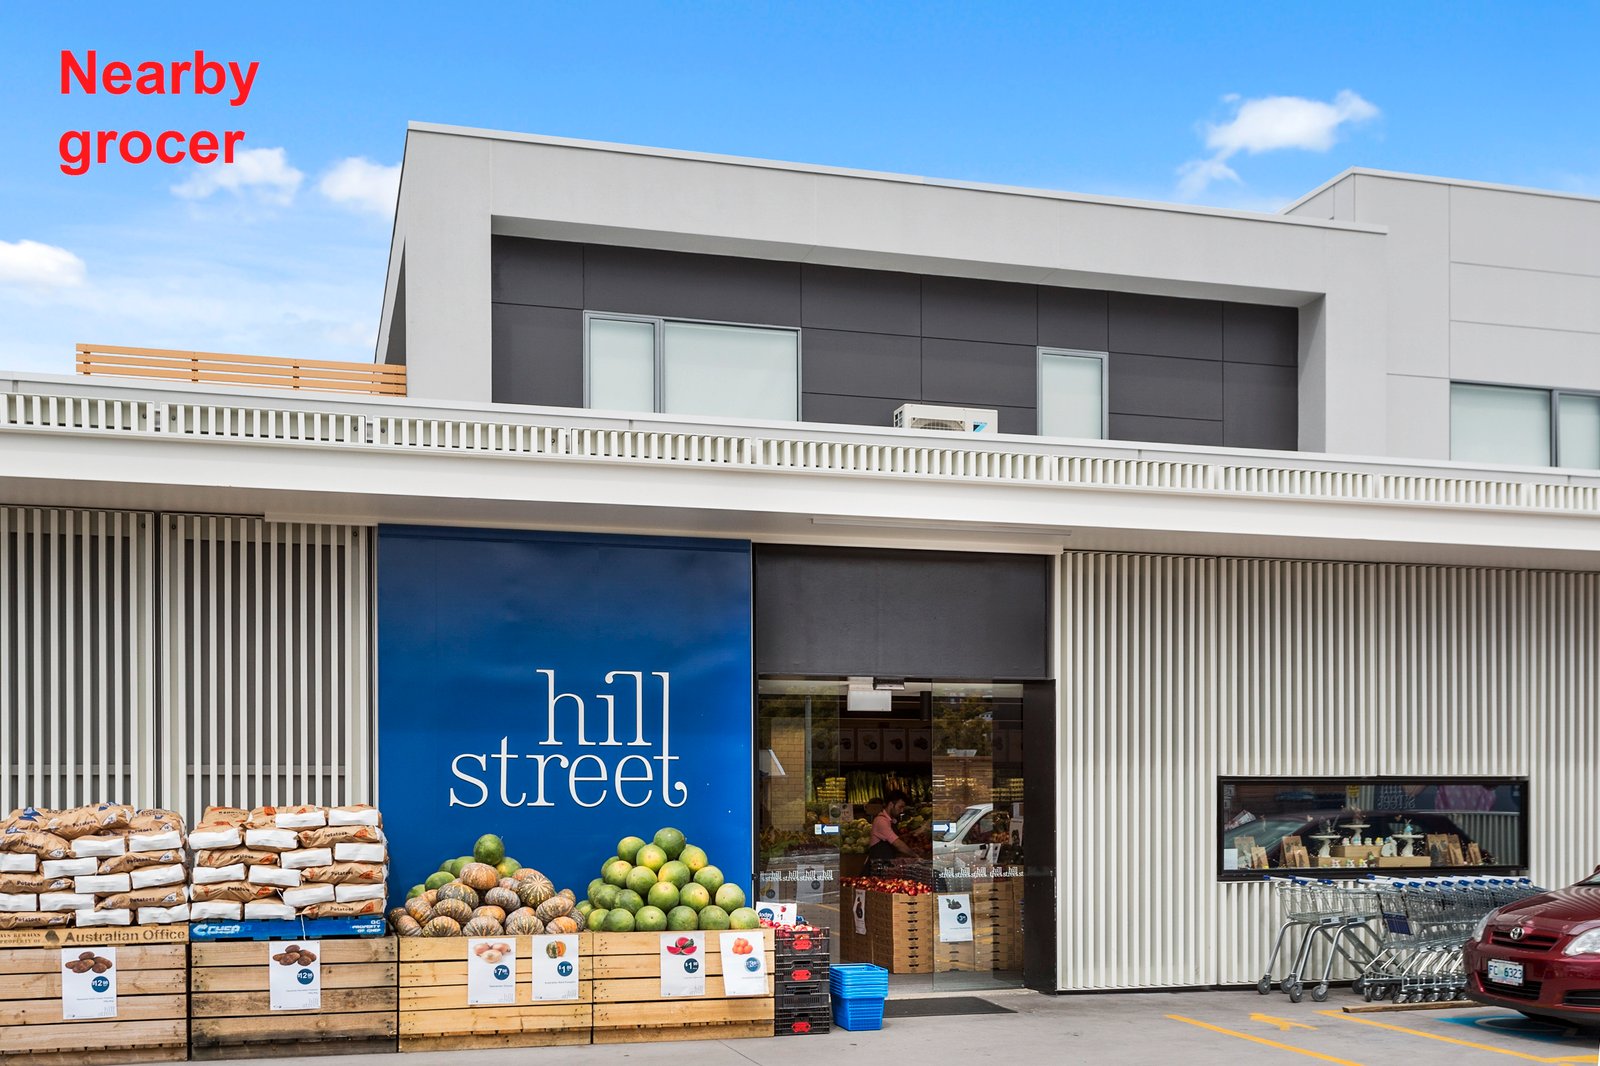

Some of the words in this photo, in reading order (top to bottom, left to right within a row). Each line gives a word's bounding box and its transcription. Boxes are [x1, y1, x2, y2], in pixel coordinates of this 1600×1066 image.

[536, 669, 669, 746] hill
[449, 735, 688, 808] street
[64, 930, 139, 943] Australian
[142, 929, 186, 941] Office
[1488, 964, 1498, 976] FC
[1503, 967, 1522, 979] 6323
